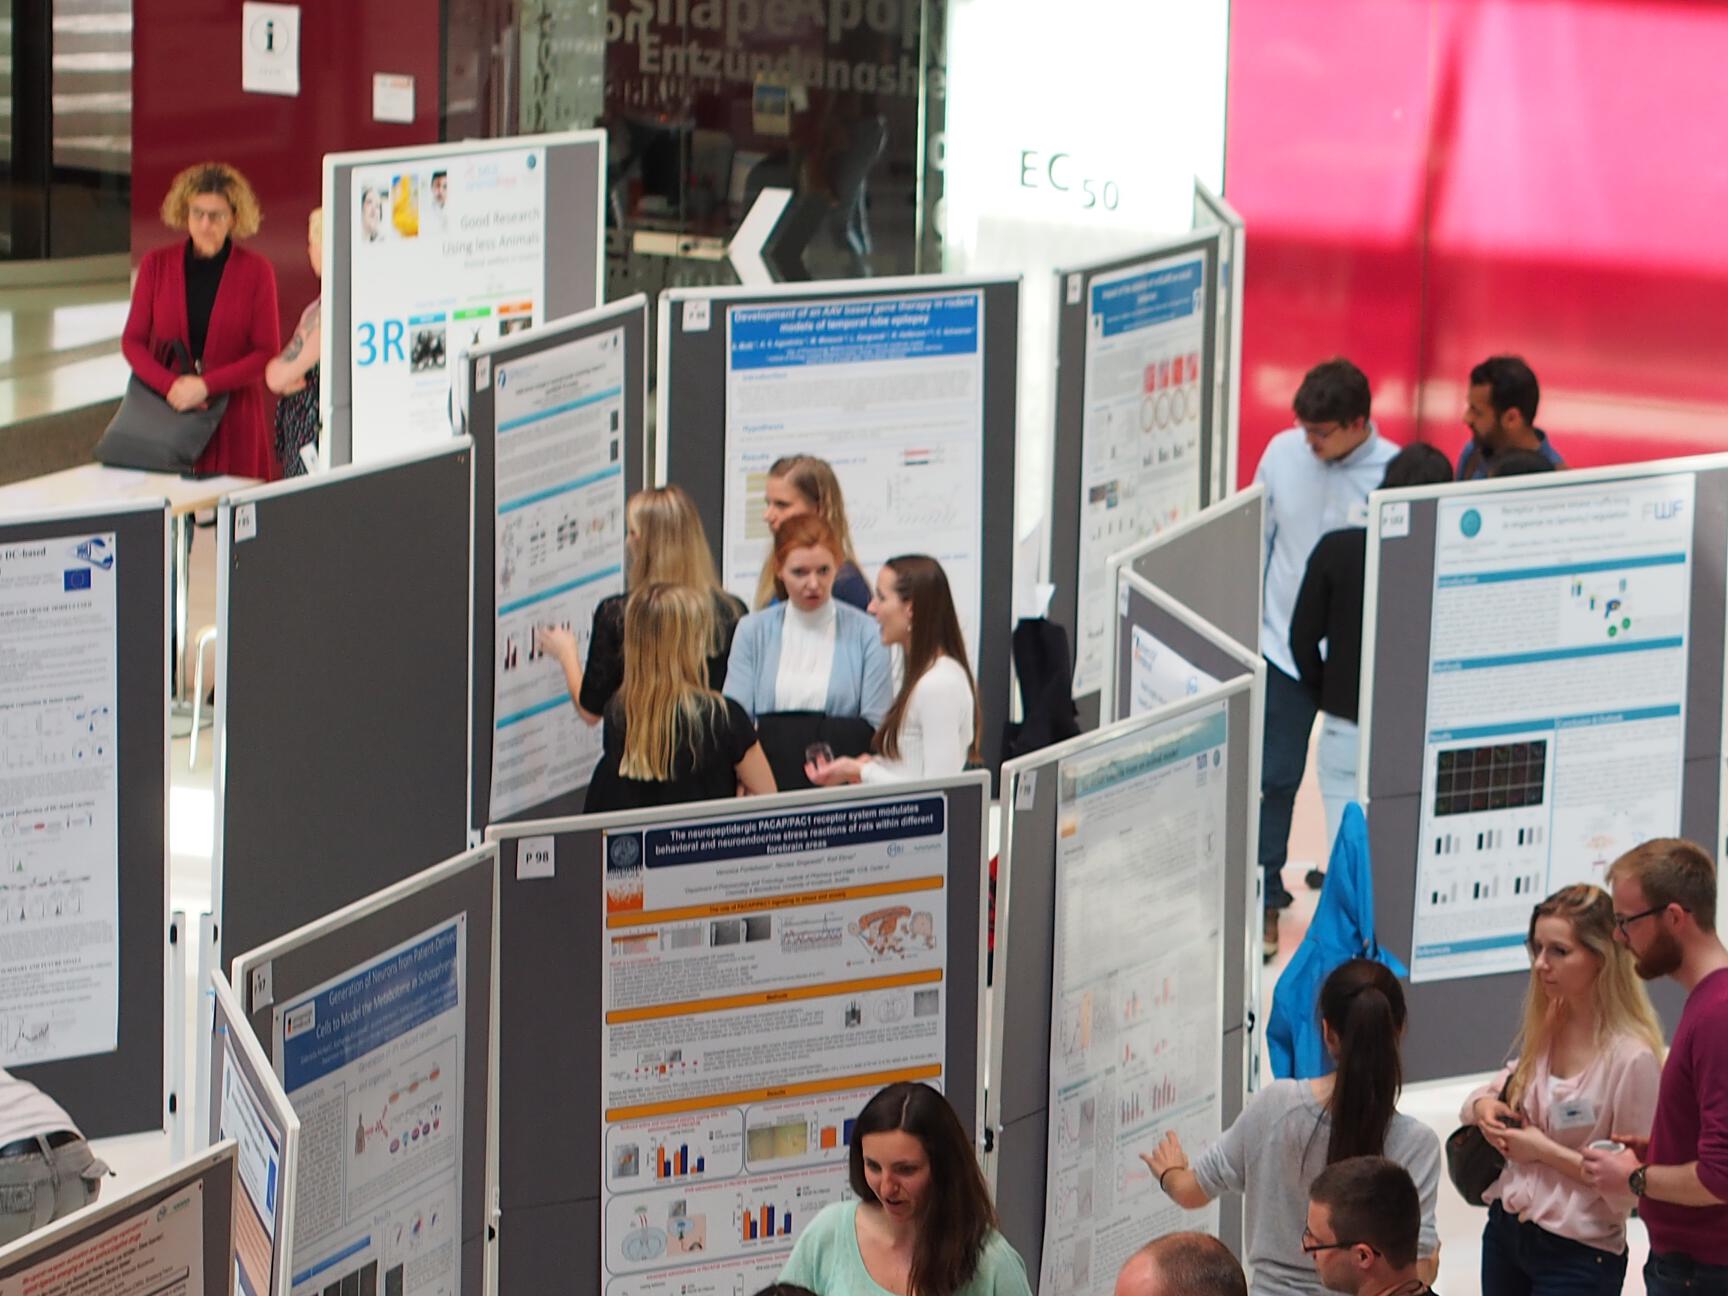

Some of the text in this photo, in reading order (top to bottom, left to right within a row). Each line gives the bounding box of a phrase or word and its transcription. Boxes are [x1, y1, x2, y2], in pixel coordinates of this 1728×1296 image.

[357, 319, 405, 367] 3R
[655, 841, 698, 855] behavioral
[700, 838, 716, 850] and
[717, 833, 781, 848] neuroendocrine
[783, 829, 808, 842] stress
[809, 823, 847, 838] reactions
[858, 821, 874, 832] rats
[875, 817, 899, 830] within
[900, 813, 934, 827] different
[670, 829, 686, 840] The
[687, 823, 757, 839] neuropeptidergic
[813, 812, 846, 825] receptor
[848, 808, 877, 821] system
[878, 803, 919, 816] modulates
[526, 852, 548, 864] P 98
[766, 839, 827, 855] forebrain areas
[329, 980, 364, 1007] Generation
[372, 963, 398, 983] Neurons
[398, 955, 413, 970] from
